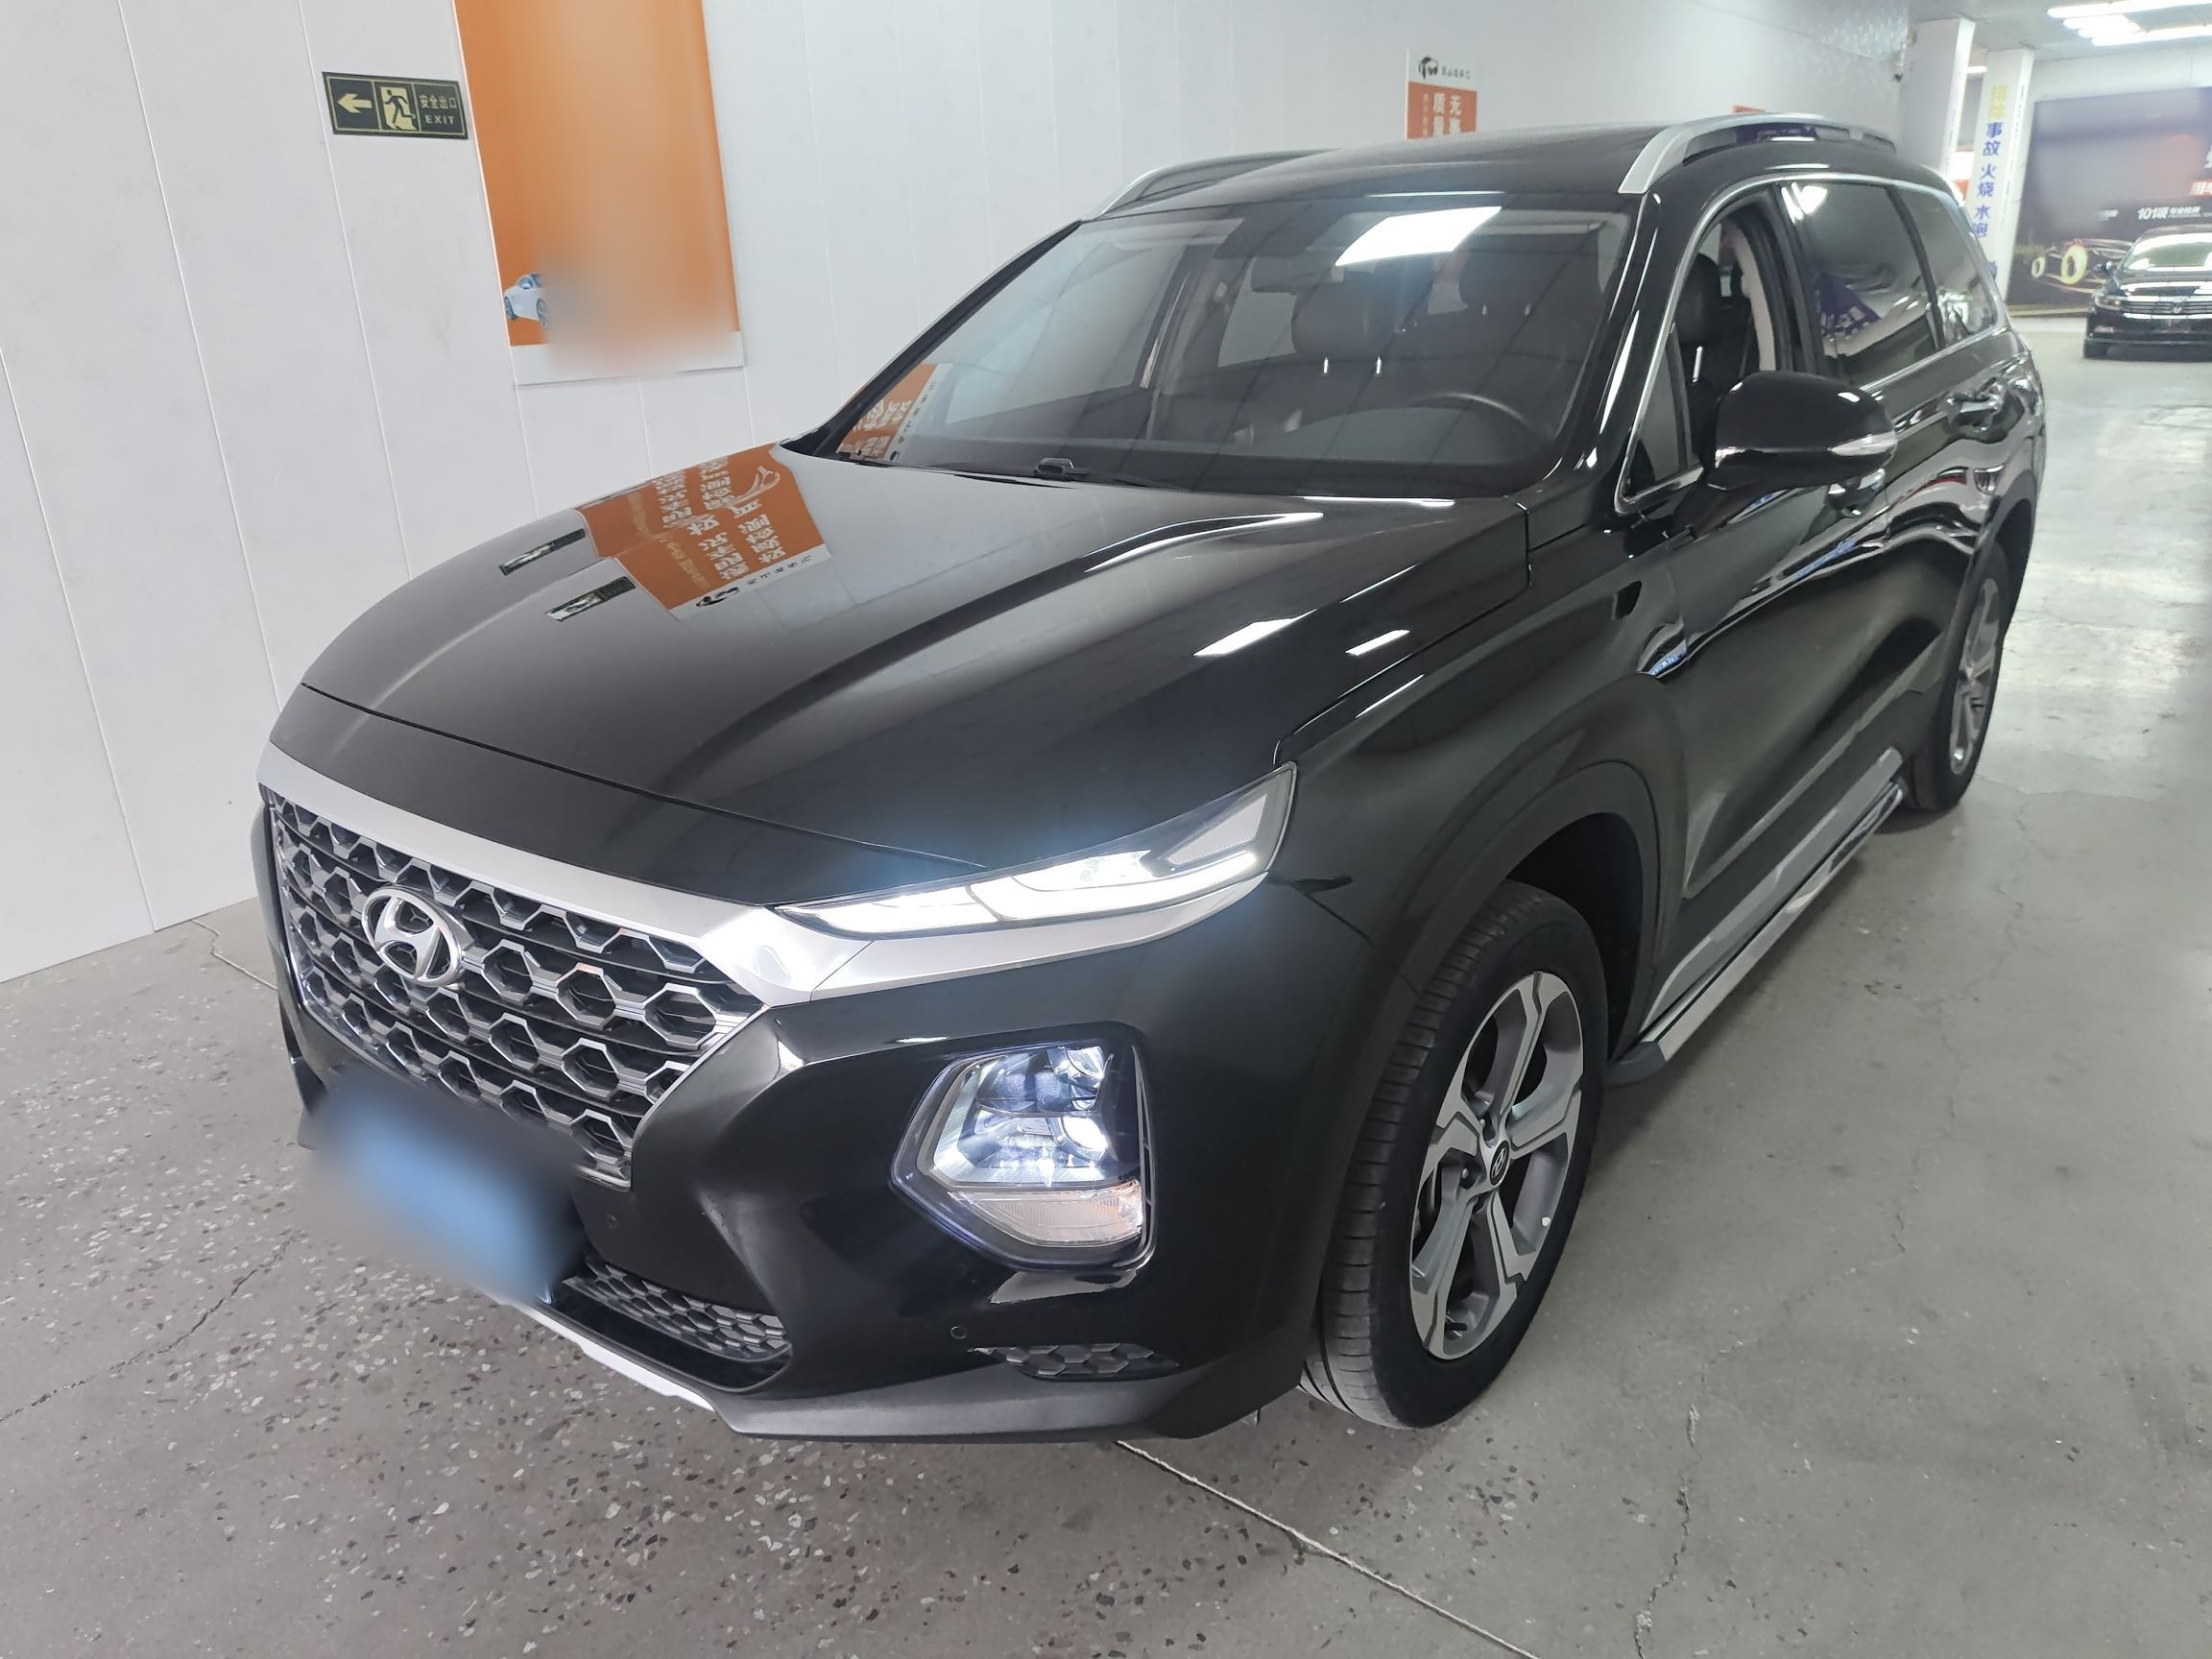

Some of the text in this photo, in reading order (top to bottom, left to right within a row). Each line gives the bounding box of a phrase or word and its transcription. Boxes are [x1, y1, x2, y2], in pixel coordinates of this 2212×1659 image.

[419, 94, 457, 109] 安全出口
[425, 114, 454, 125] EXIT
